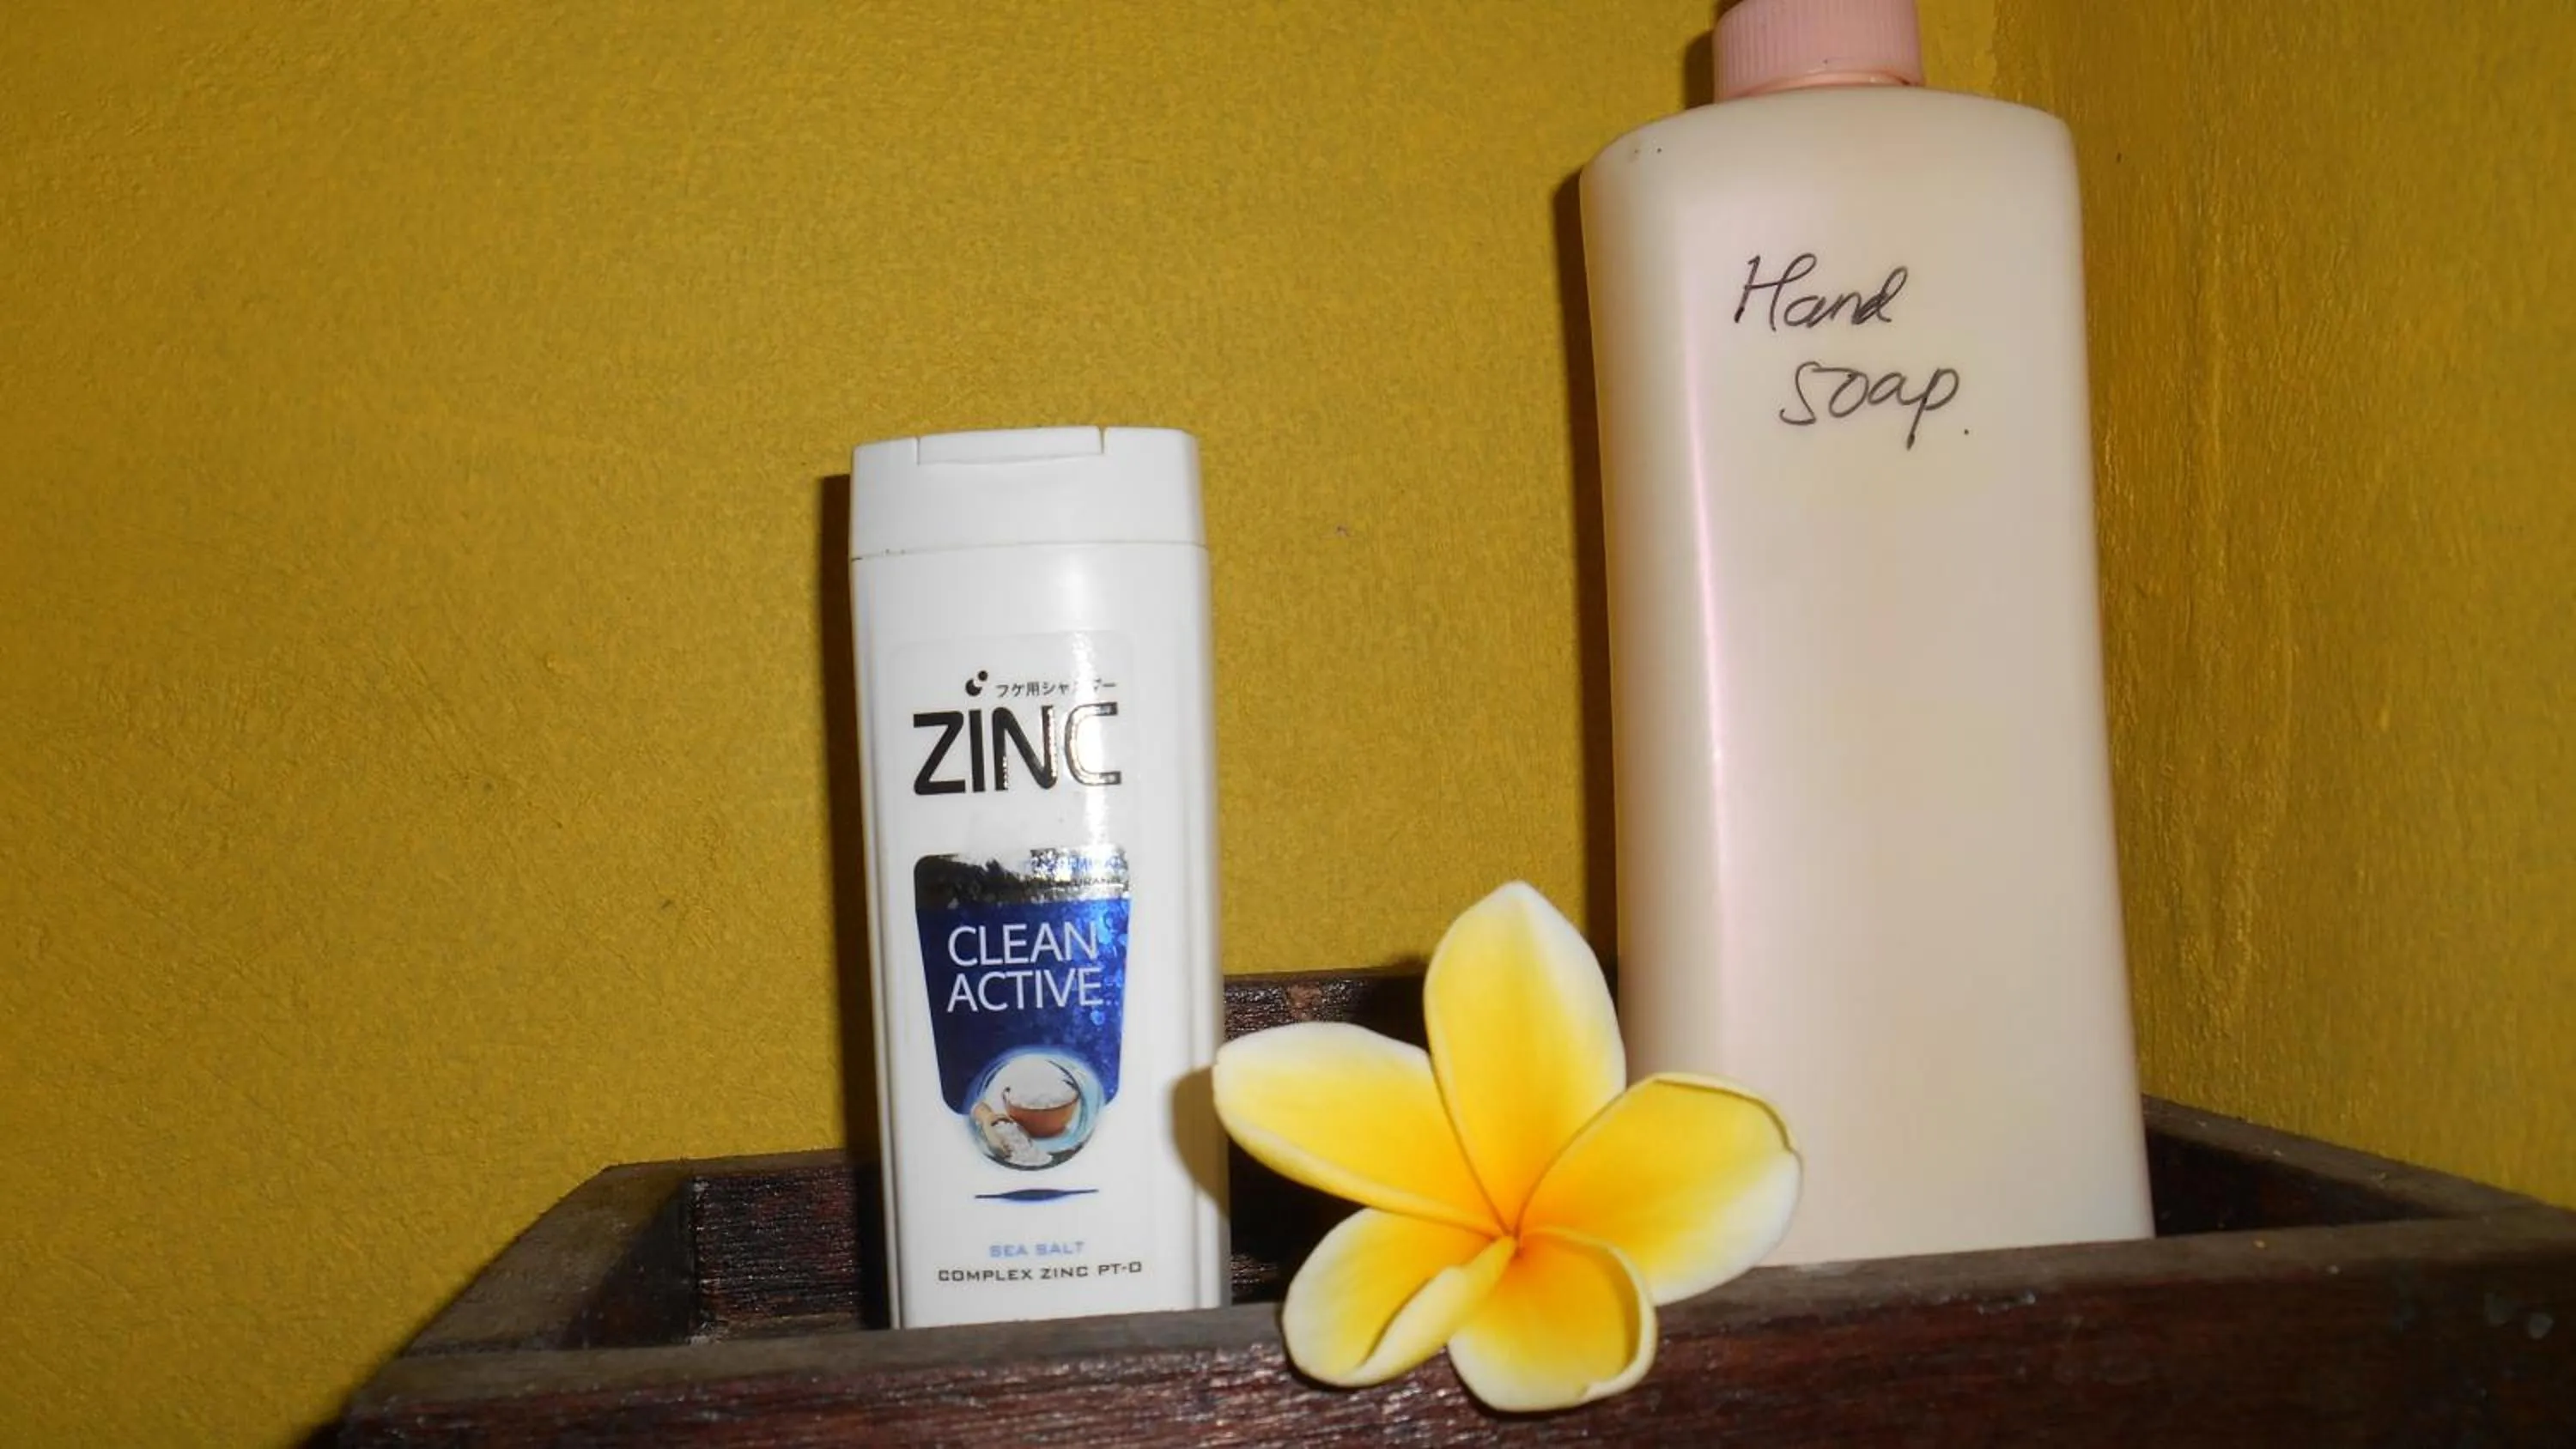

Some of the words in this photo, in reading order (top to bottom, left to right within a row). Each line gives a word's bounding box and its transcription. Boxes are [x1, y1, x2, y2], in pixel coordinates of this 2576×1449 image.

[1734, 252, 1908, 332] Hand
[947, 921, 1099, 967] CLEAN
[947, 967, 1104, 1013] ACTIVE
[989, 1244, 1029, 1258] SEA
[1035, 1240, 1084, 1256] SALT
[938, 1267, 1034, 1282] COMPLEX
[1040, 1265, 1089, 1280] ZINC
